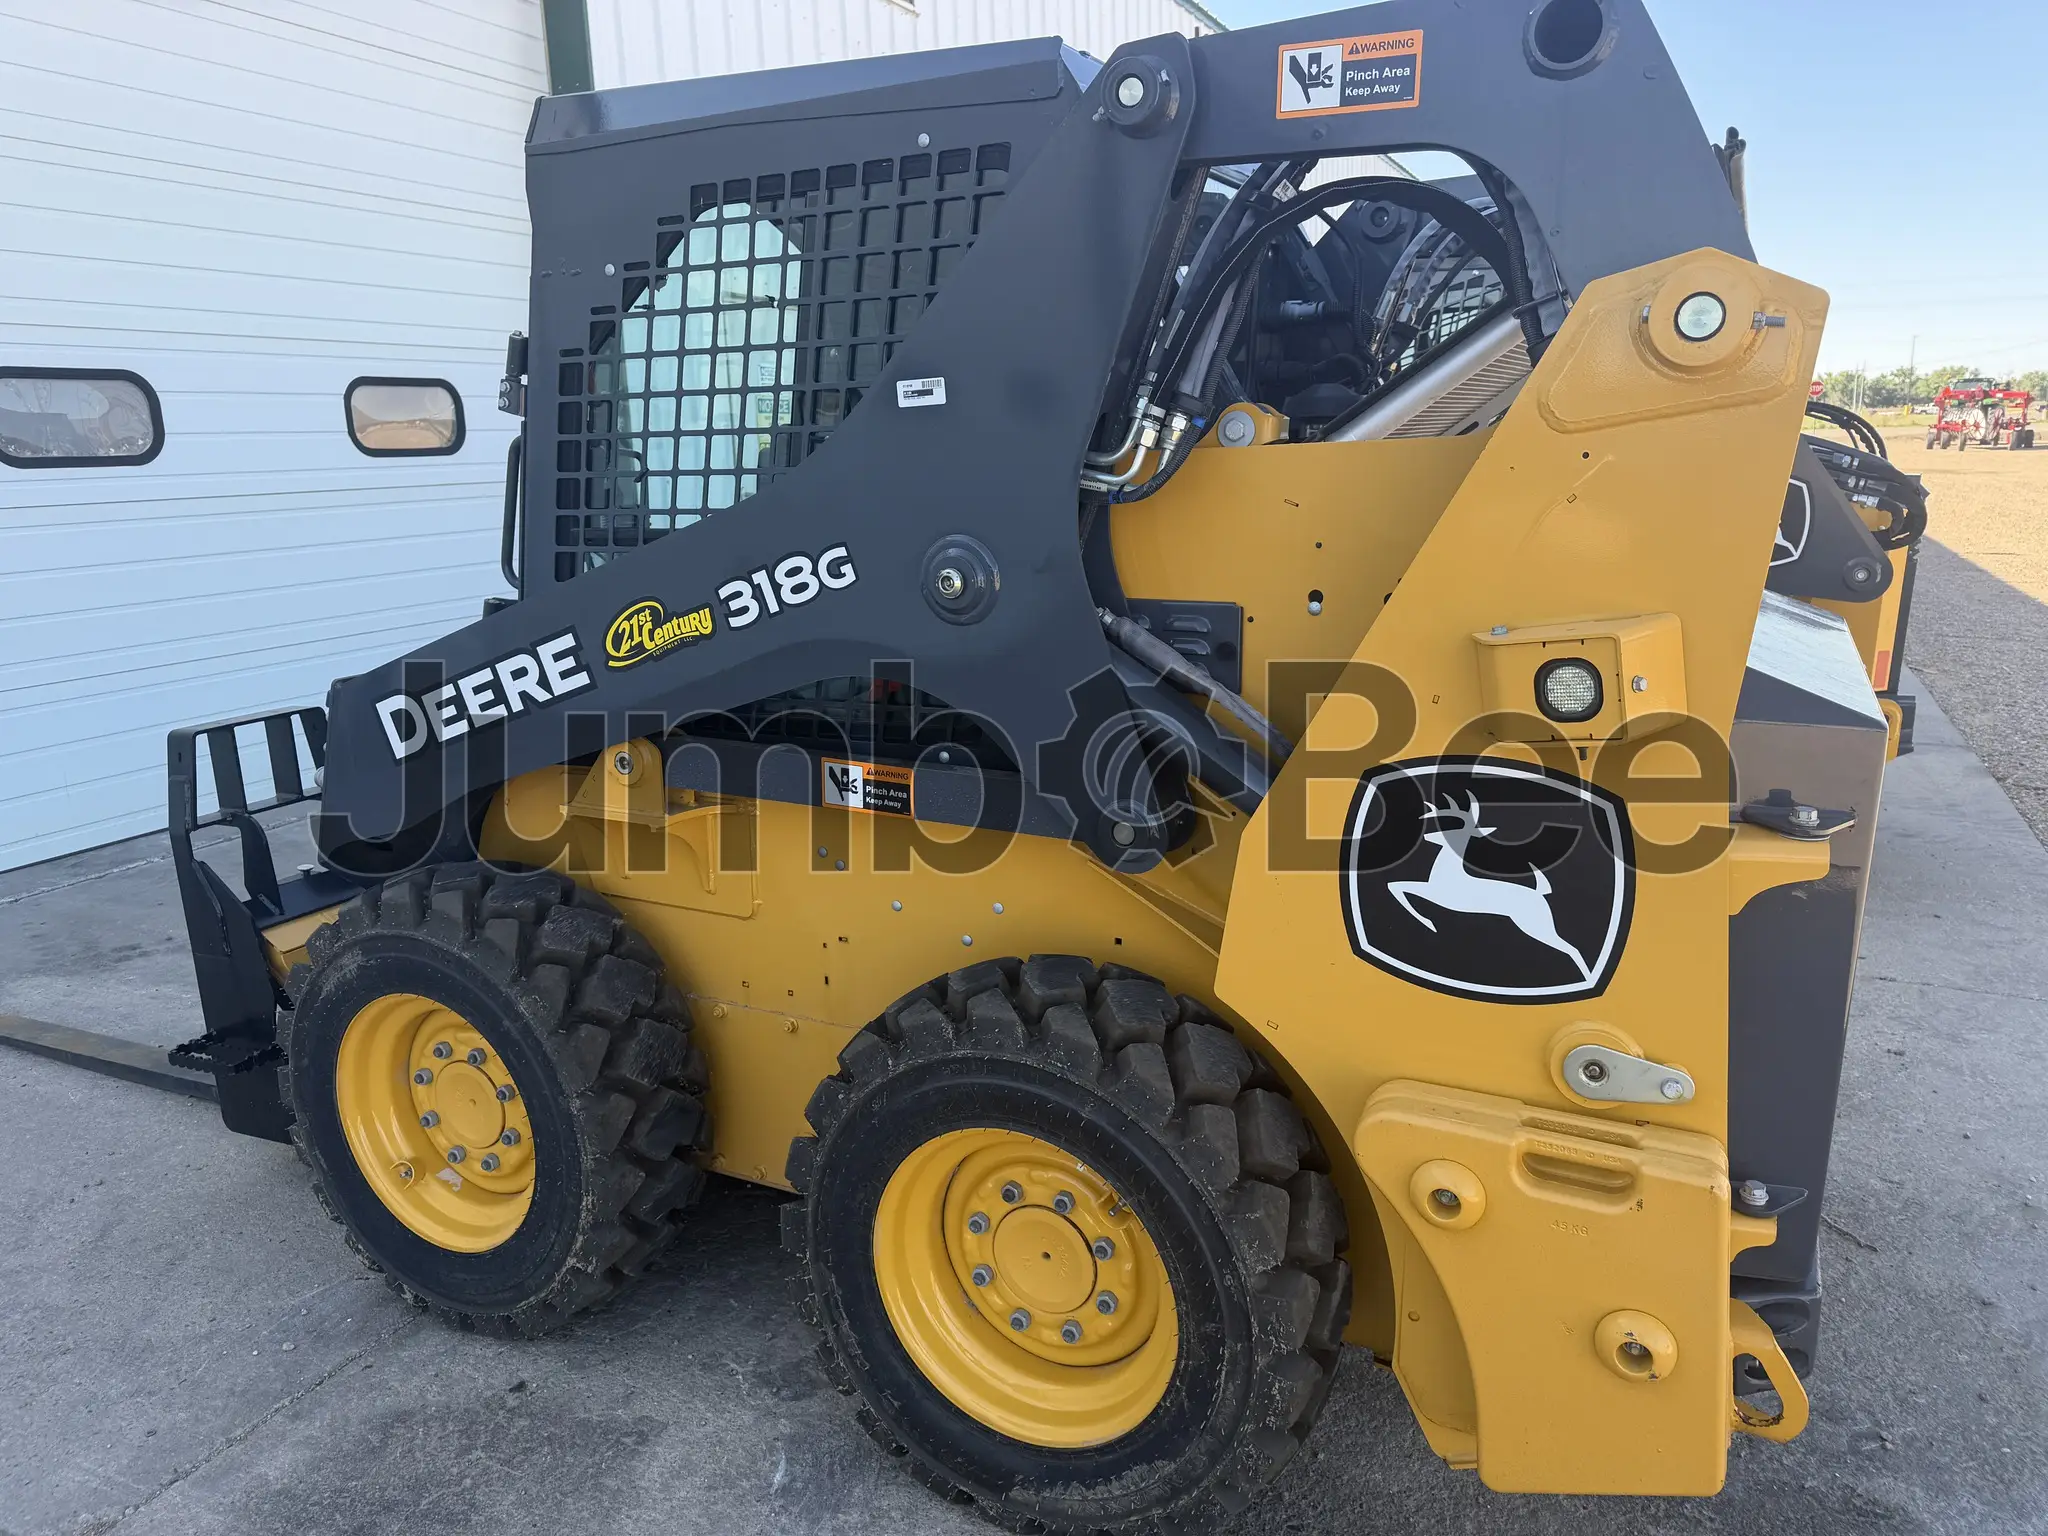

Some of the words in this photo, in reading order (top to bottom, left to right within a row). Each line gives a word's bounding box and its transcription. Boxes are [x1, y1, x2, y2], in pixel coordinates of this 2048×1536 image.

[1361, 38, 1415, 53] WARNING
[1346, 68, 1379, 81] Pinch
[1382, 67, 1410, 78] Area
[1345, 86, 1371, 97] Keep
[1373, 84, 1400, 94] Away
[1810, 384, 1823, 392] STOP
[718, 546, 857, 628] 318G
[618, 608, 653, 657] 21st
[652, 639, 681, 657] EQUIPMENT
[375, 633, 591, 759] DEERE
[874, 769, 909, 780] WARNING
[866, 785, 888, 796] Pinch
[889, 789, 907, 799] Area
[866, 796, 883, 806] Keep
[884, 799, 902, 809] Away
